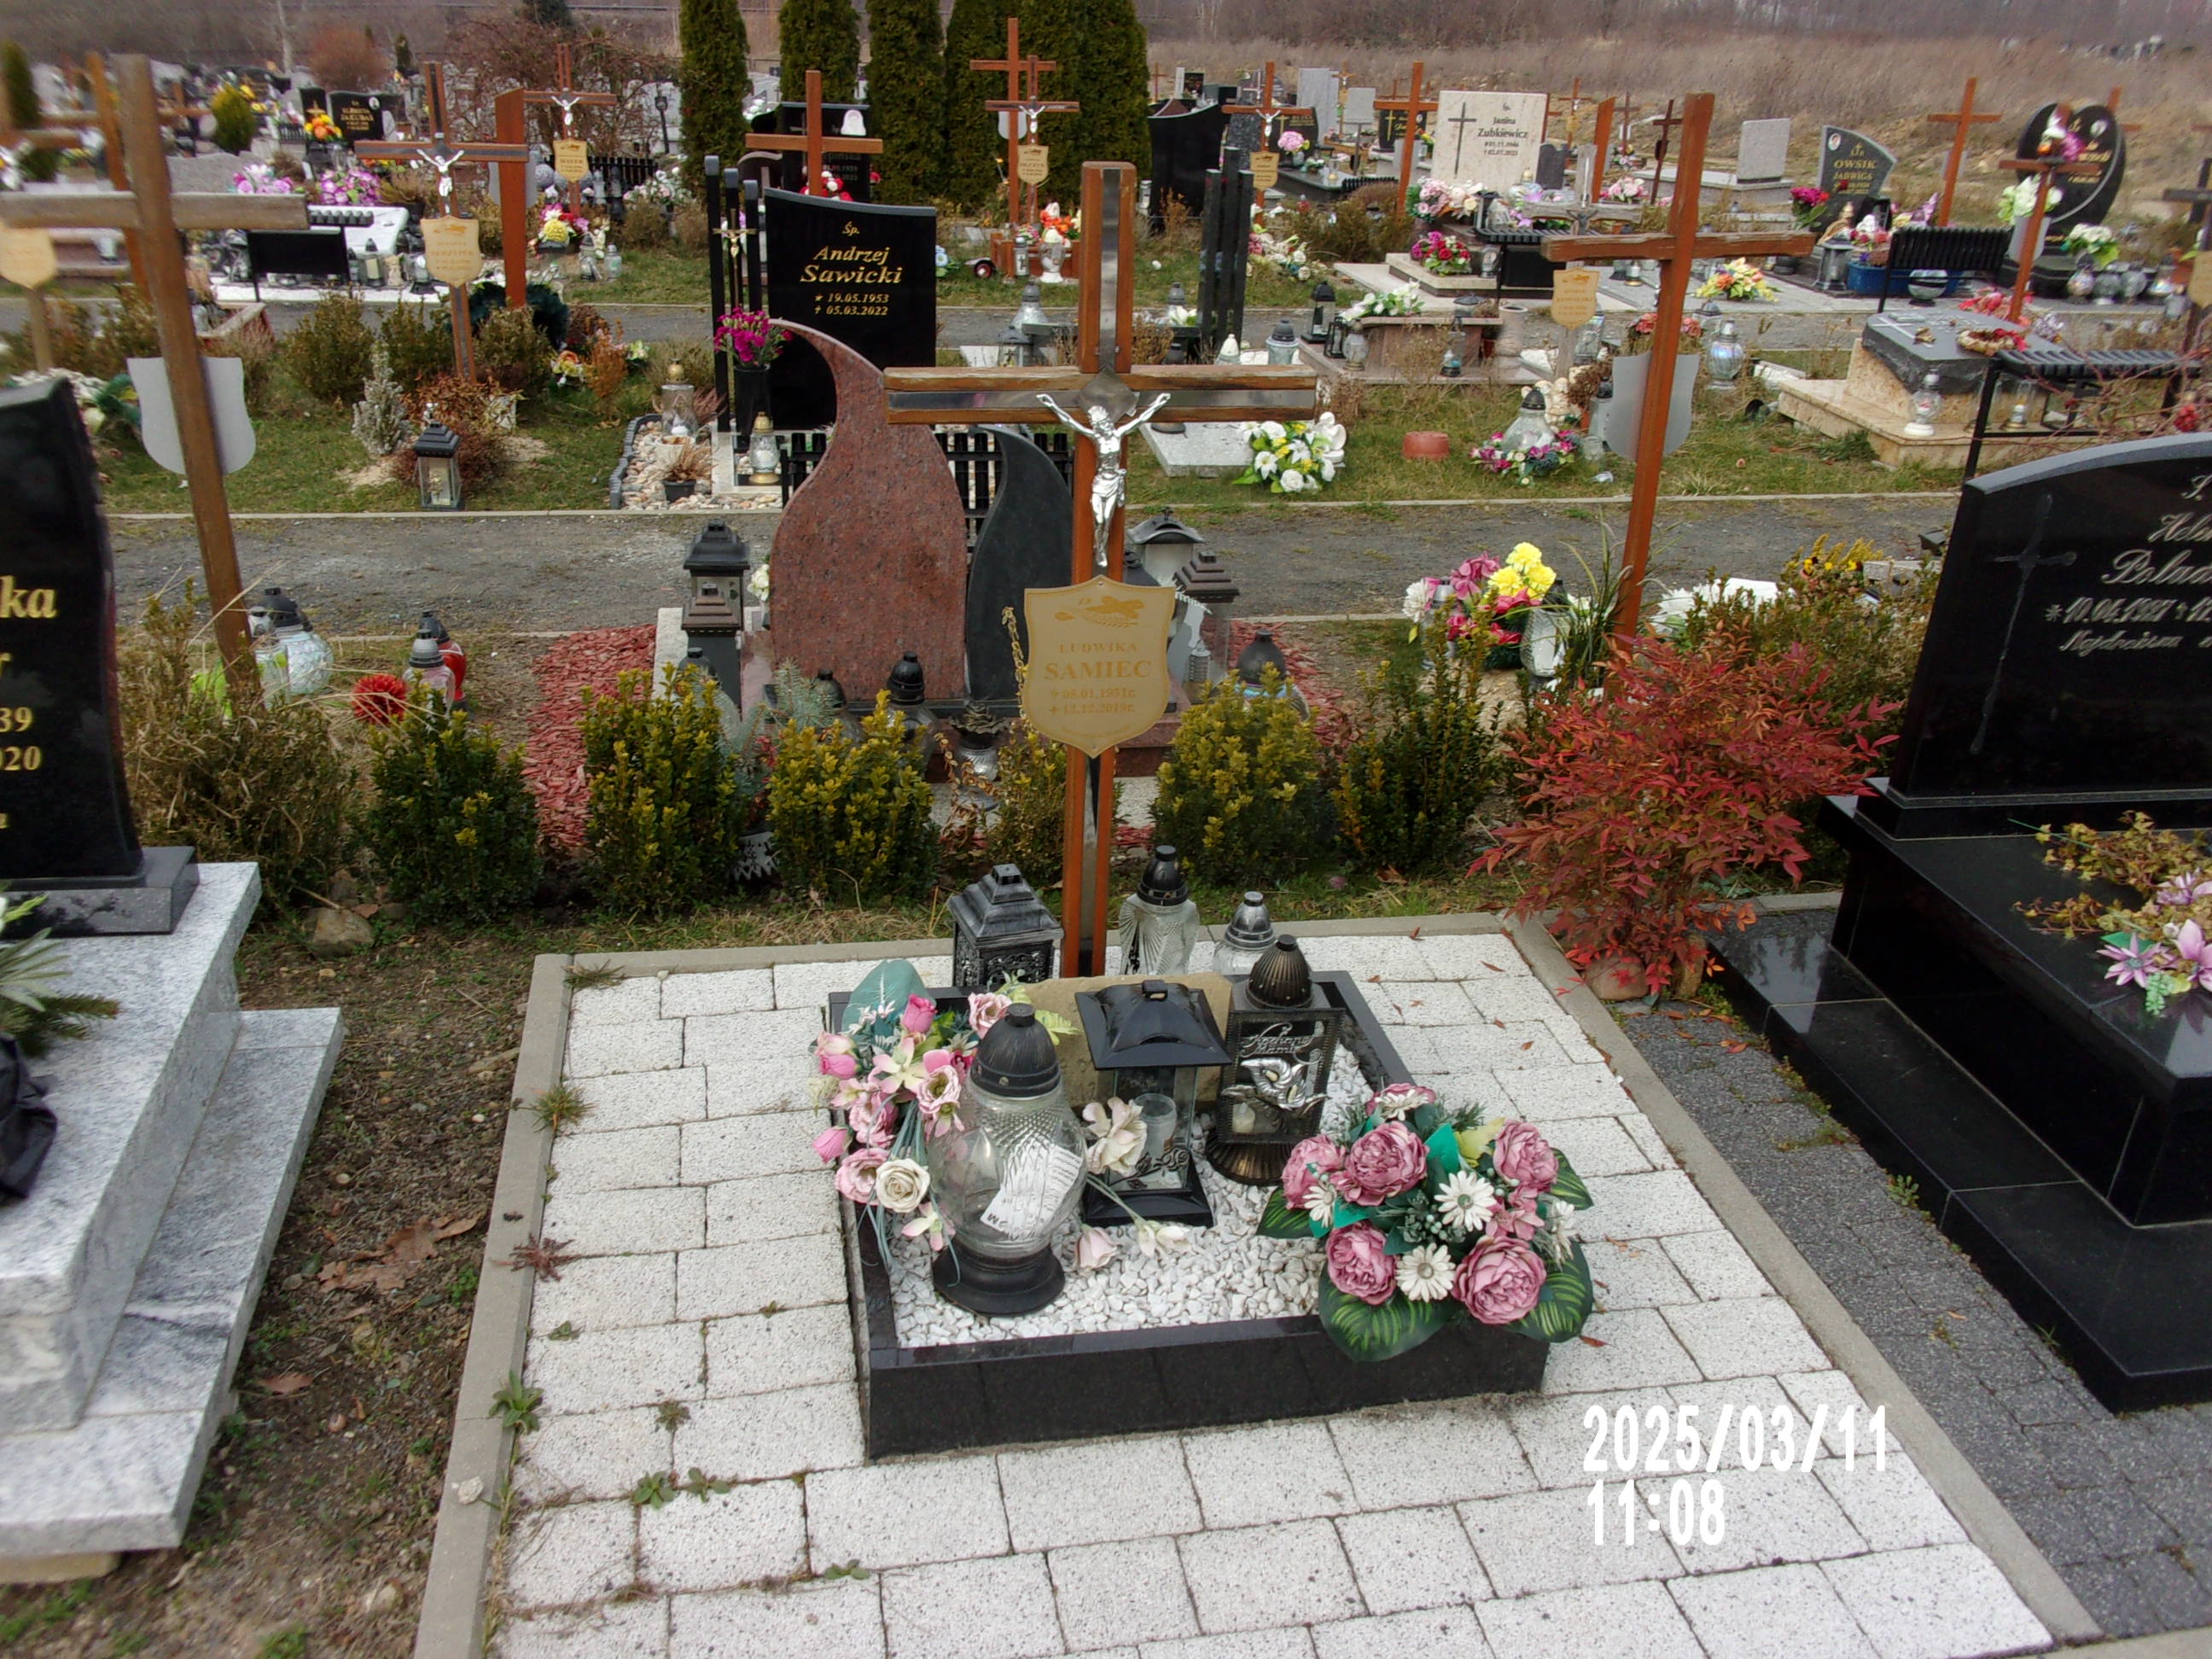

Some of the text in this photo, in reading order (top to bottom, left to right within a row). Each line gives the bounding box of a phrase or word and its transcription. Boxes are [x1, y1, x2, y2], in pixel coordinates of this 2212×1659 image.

[812, 245, 891, 265] Andrzej
[799, 264, 903, 283] Sawicki
[827, 293, 889, 303] 19.05.1953
[825, 306, 888, 315] 05.03.2022
[1044, 661, 1152, 681] SAMIEC
[0, 746, 42, 771] 20
